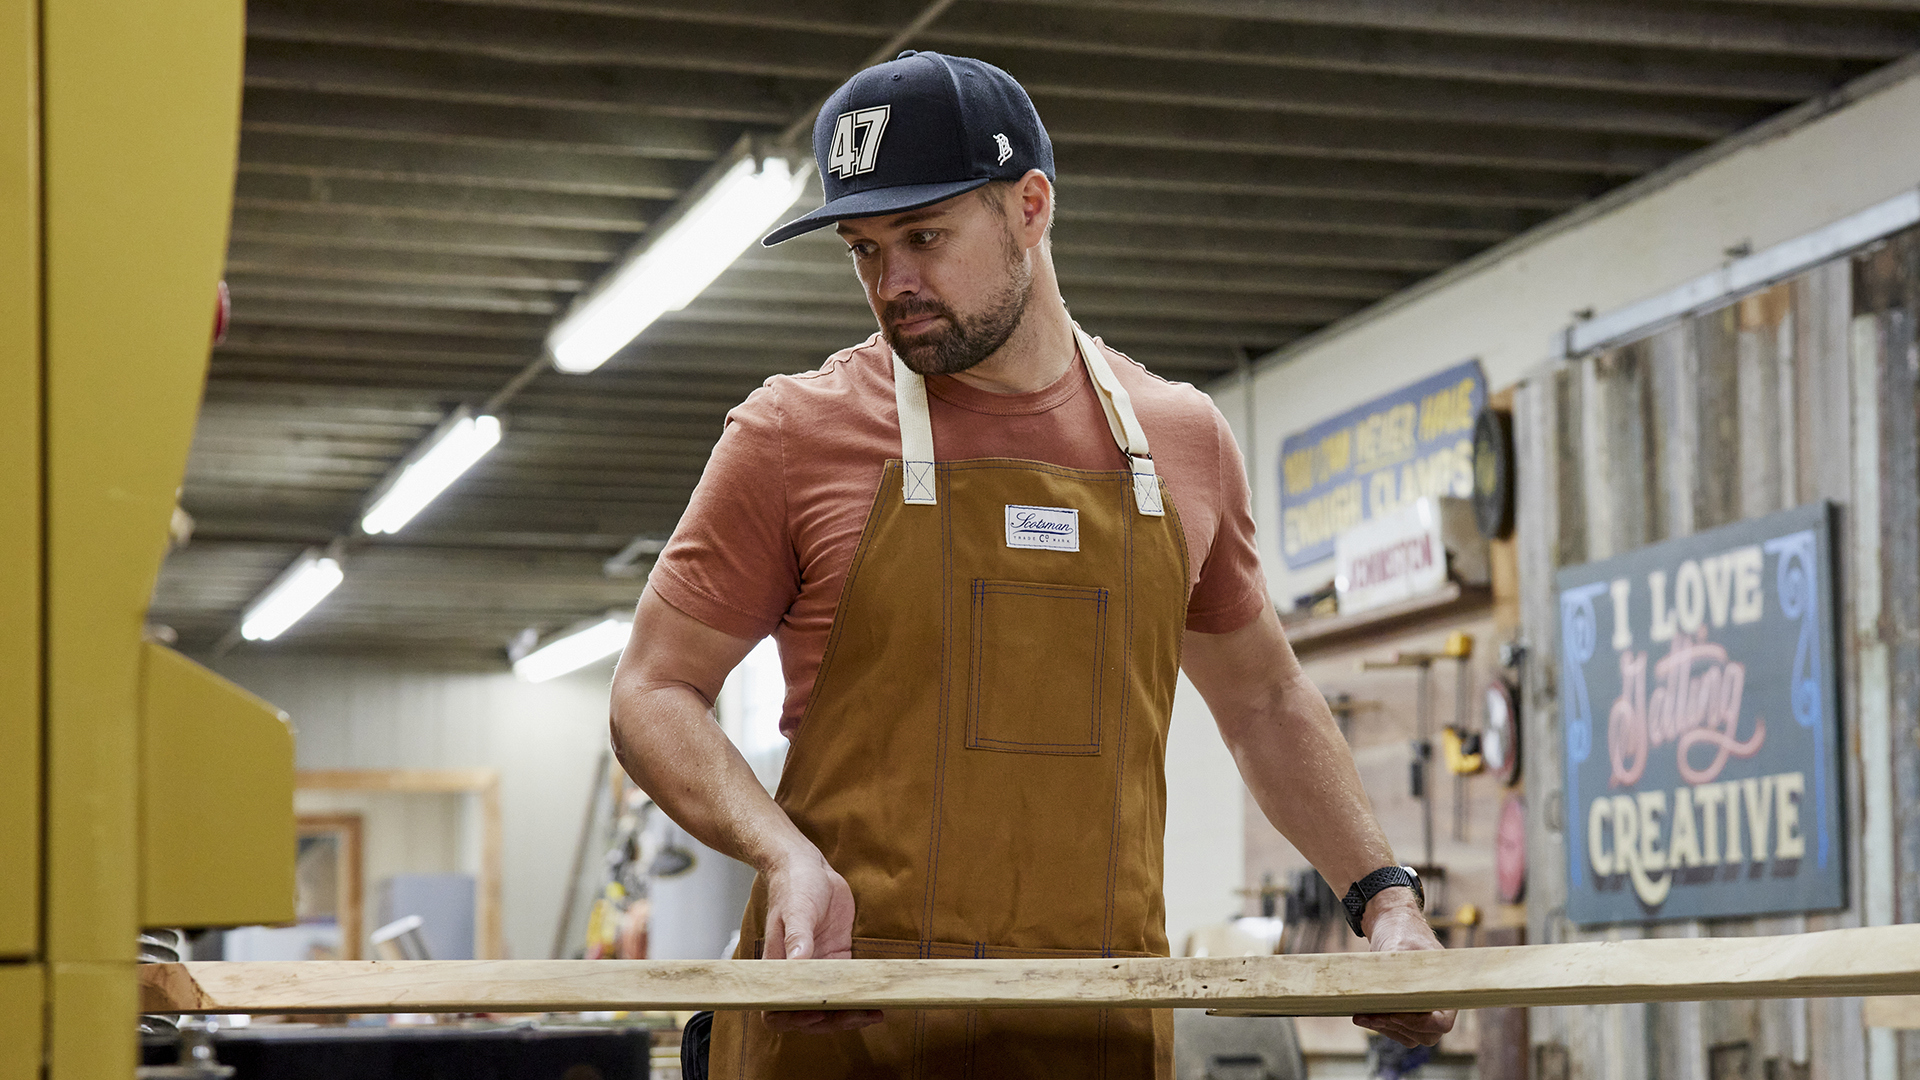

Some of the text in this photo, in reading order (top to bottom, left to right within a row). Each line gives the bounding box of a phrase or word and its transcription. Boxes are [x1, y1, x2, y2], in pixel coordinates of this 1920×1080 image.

[828, 104, 891, 180] 47
[1356, 401, 1417, 463] NEVER
[1418, 377, 1476, 442] HAVE
[1010, 511, 1074, 533] Scotsman
[1283, 480, 1363, 557] ENOUGH
[1369, 438, 1475, 520] CLAMPS
[1610, 545, 1764, 651] I LOVE
[1587, 771, 1805, 907] CREATIVE
